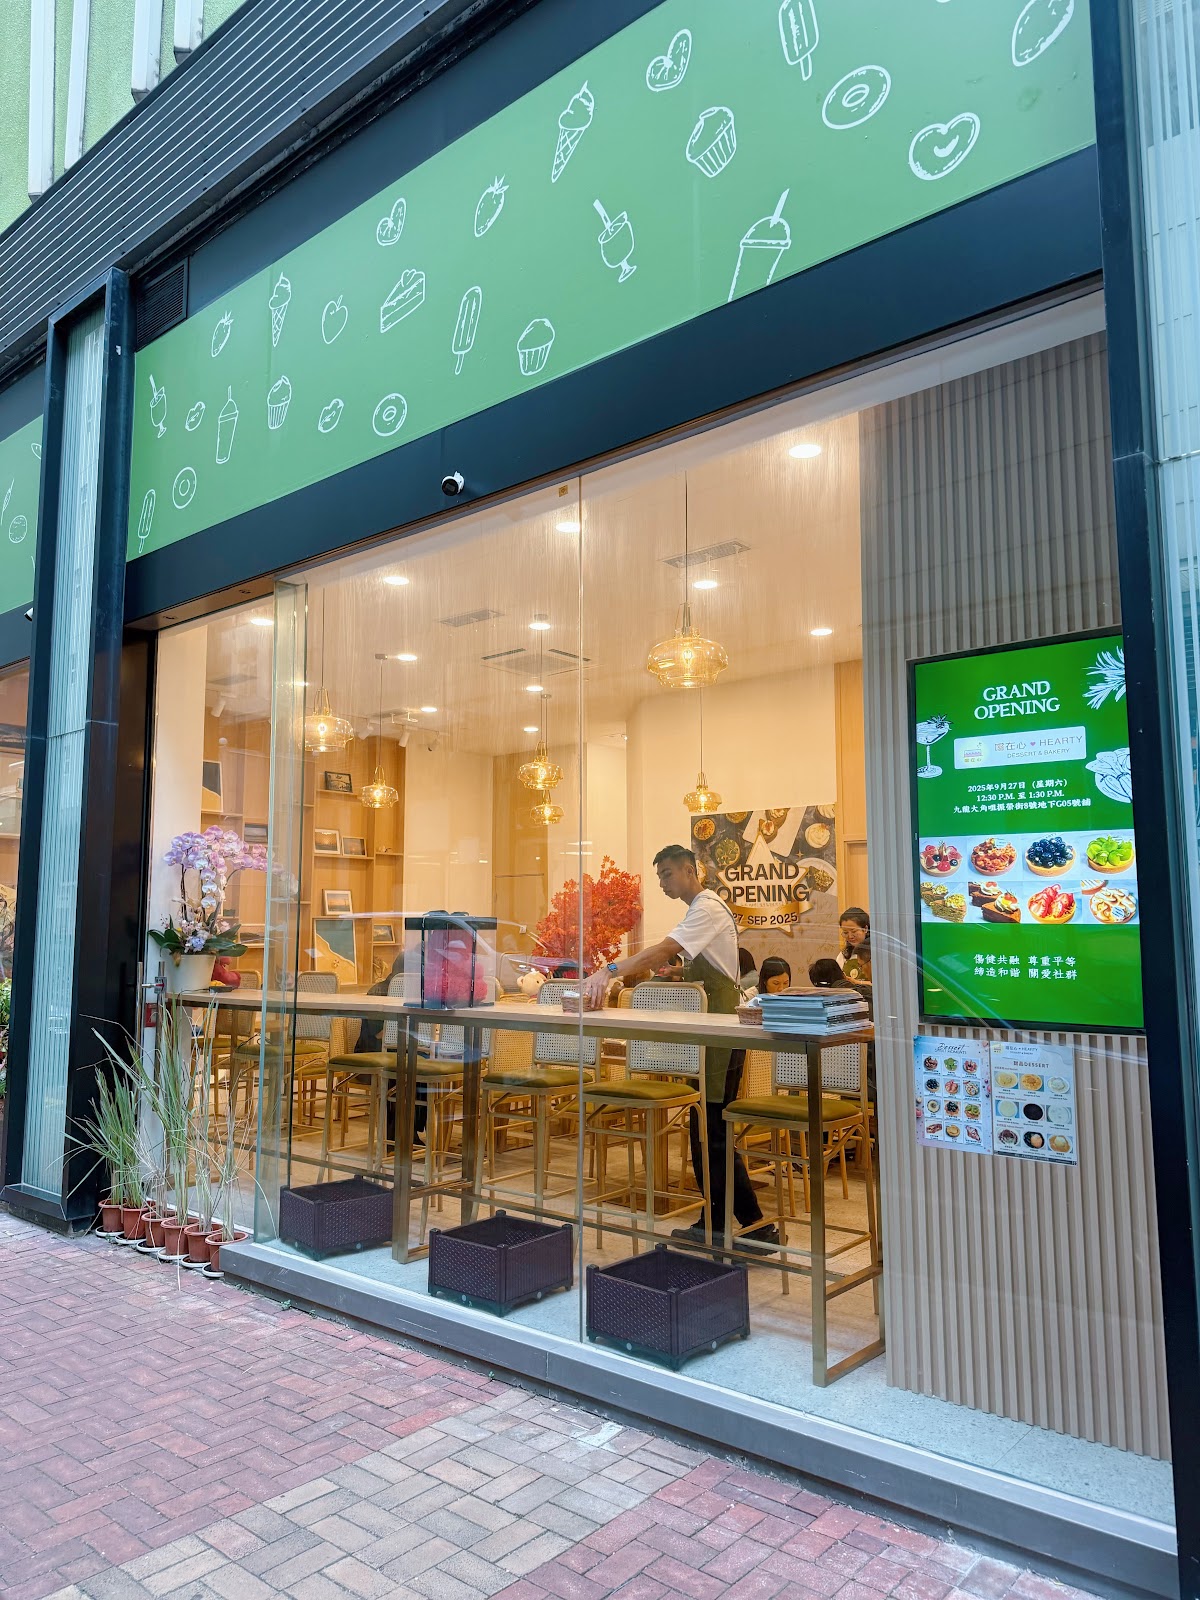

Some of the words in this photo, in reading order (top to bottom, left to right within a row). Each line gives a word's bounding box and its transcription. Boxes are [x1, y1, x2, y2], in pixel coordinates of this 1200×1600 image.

[983, 680, 1051, 702] GRAND
[974, 697, 1061, 720] OPENING
[1039, 735, 1083, 747] HEARTY
[1007, 750, 1036, 759] DESSERT
[1044, 748, 1070, 756] BAKERY
[968, 781, 1026, 793] 2025年9月27日
[976, 794, 997, 802] 12:30
[998, 793, 1015, 801] P.M.
[1017, 792, 1026, 800] 至
[1028, 791, 1045, 799] 1:30
[1046, 789, 1064, 798] P.M.
[725, 863, 799, 881] GRAND
[717, 884, 810, 902] OPENING
[747, 916, 767, 925] SEP
[770, 913, 797, 925] 2025
[973, 953, 1020, 966] 傷健共融
[1028, 955, 1077, 967] 尊重平等
[1028, 968, 1078, 981] 關愛社群
